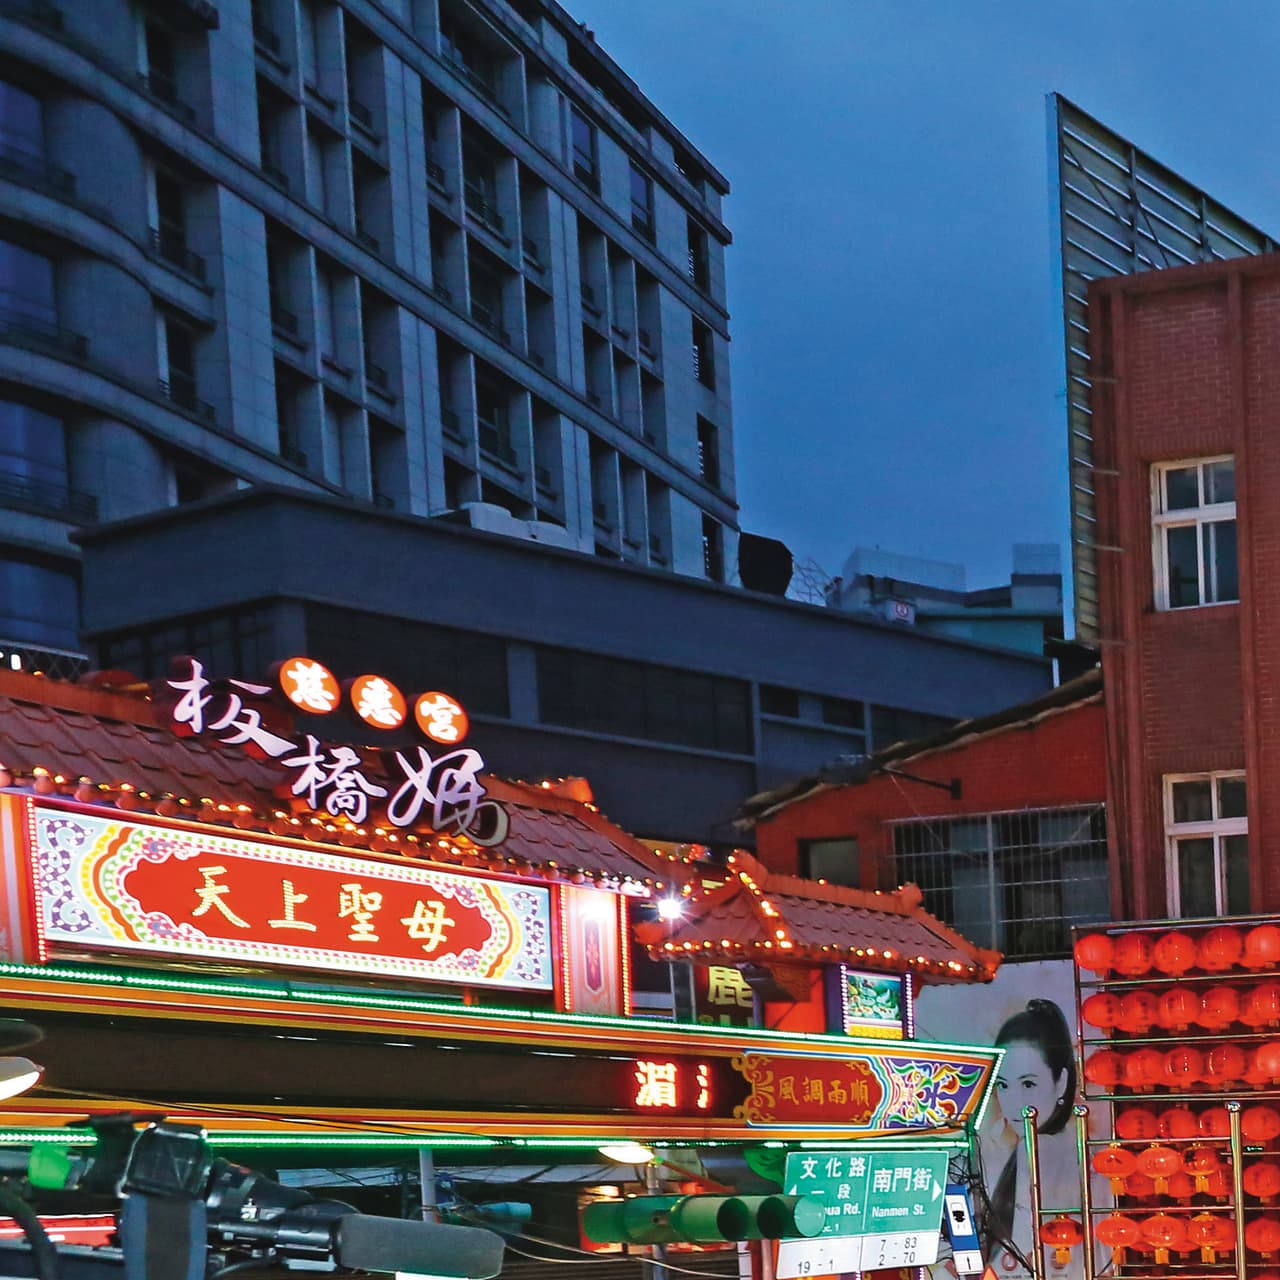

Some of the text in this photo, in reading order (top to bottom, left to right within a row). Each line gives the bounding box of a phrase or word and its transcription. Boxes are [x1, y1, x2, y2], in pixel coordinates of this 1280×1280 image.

[281, 658, 467, 745] 慈惠宮
[190, 865, 456, 951] 天上聖母
[778, 1076, 870, 1107] 風調雨順
[800, 1156, 868, 1178] 文化路
[872, 1167, 932, 1193] 南門街
[811, 1184, 851, 1199] 一段
[842, 1202, 862, 1215] Rd.
[871, 1203, 926, 1219] Nanmen St.
[880, 1240, 887, 1251] 7
[904, 1237, 917, 1249] 83
[797, 1261, 811, 1274] 19
[828, 1259, 835, 1271] 1
[879, 1254, 886, 1266] 2
[903, 1251, 916, 1263] 70
